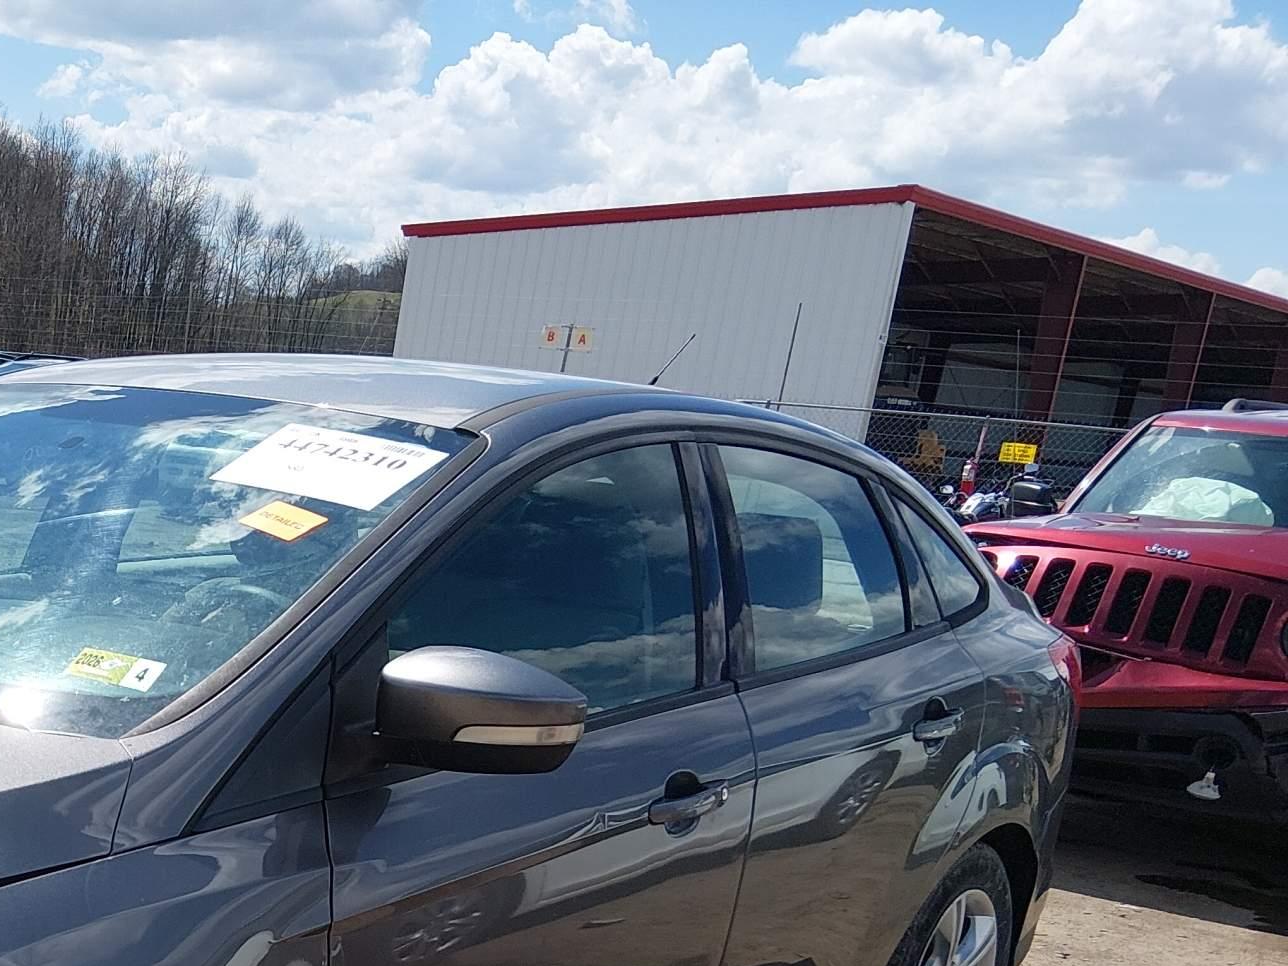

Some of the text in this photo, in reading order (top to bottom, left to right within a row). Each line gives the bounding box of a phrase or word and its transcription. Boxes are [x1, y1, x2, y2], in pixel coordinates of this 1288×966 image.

[547, 331, 555, 341] B
[578, 334, 586, 344] A
[279, 439, 407, 470] 44742310
[1144, 543, 1191, 561] Jeep
[75, 653, 104, 668] 2026
[135, 668, 149, 682] 4
